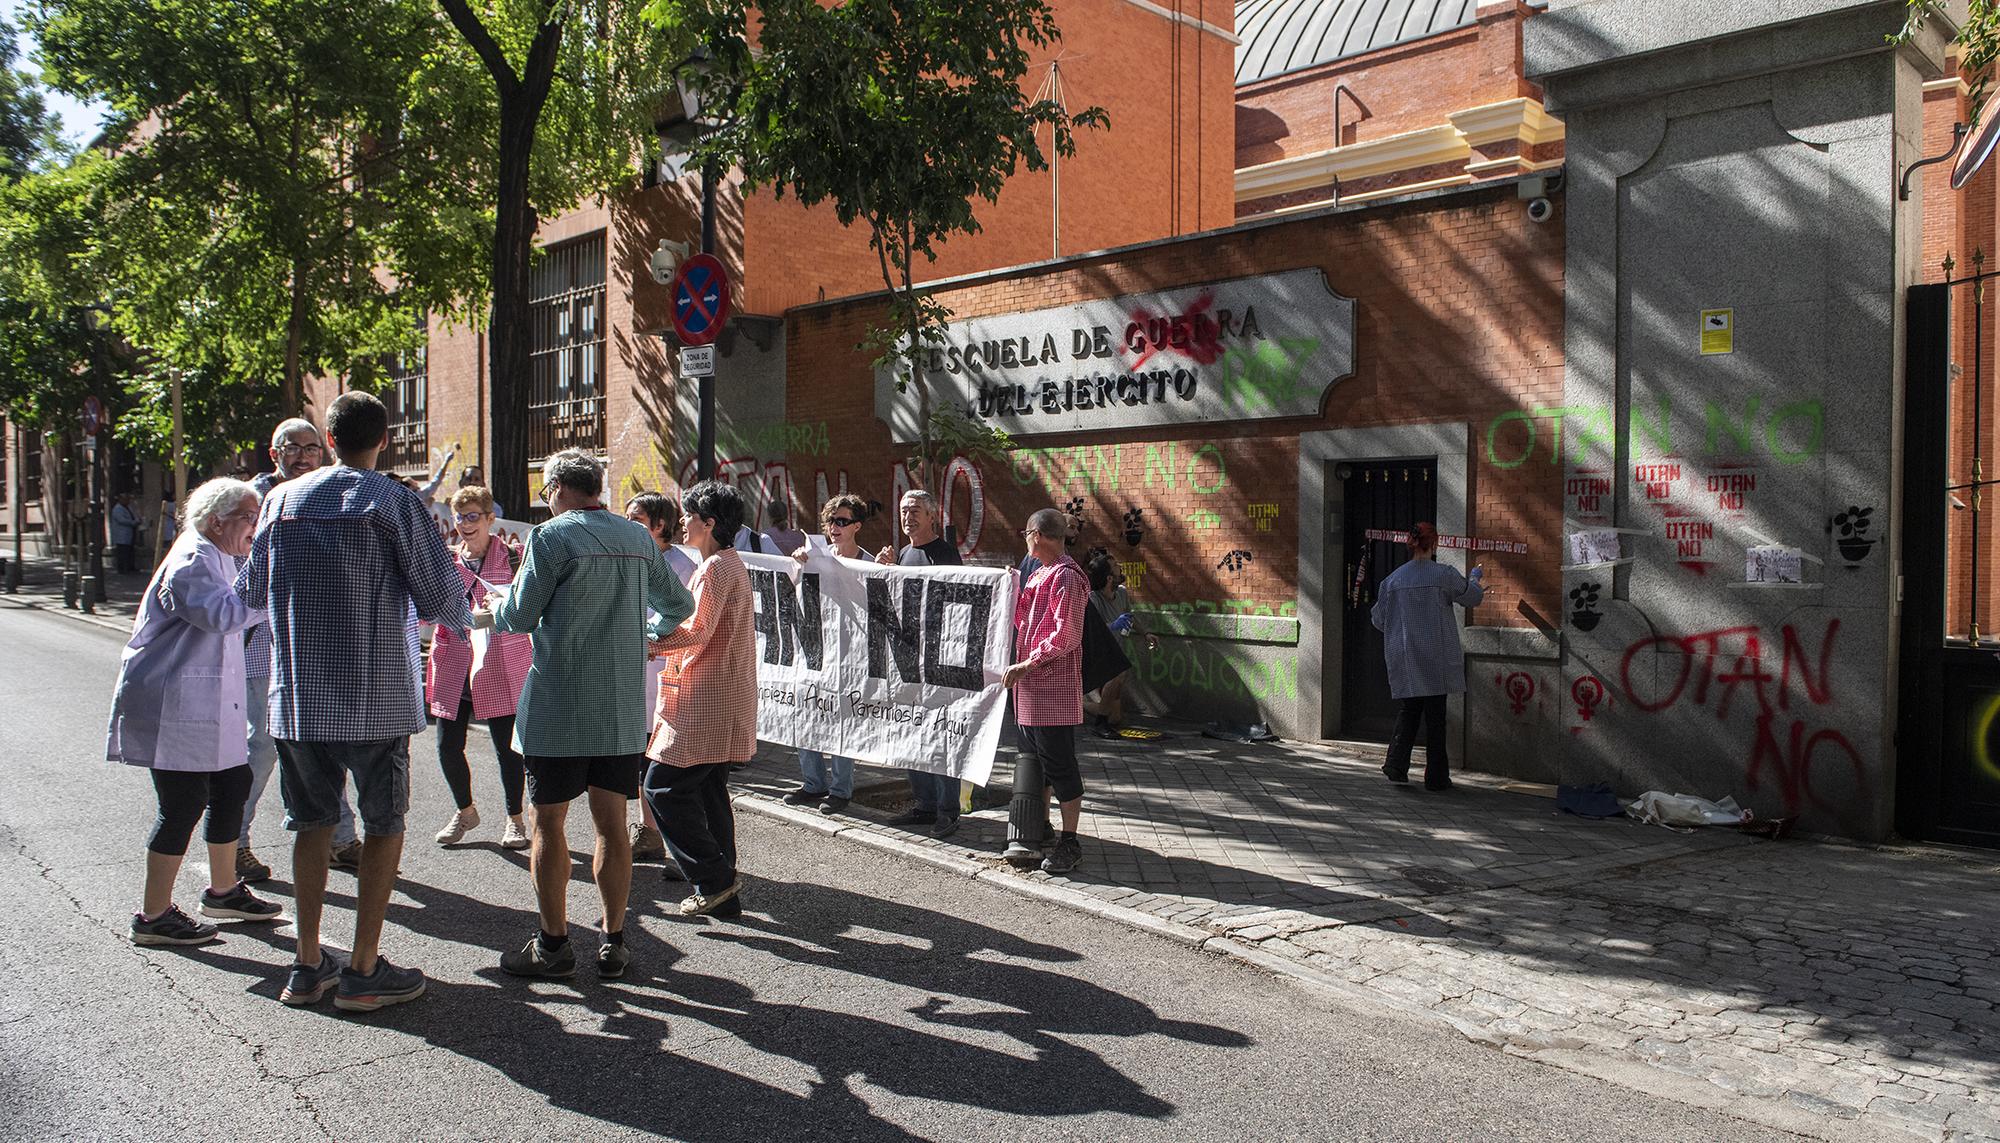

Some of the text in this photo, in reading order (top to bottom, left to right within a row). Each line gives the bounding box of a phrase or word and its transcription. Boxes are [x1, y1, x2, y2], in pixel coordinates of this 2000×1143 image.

[686, 352, 709, 361] ZONA DE
[928, 332, 1059, 376] ESCUELA
[1071, 325, 1112, 360] DE
[683, 361, 711, 371] SEGURIDAD
[977, 368, 1197, 418] DEL EJERCITO
[1486, 390, 1826, 469] OTAN NO
[1013, 440, 1226, 496] OTAN NO
[1635, 464, 1681, 482] OTAN
[1567, 478, 1610, 496] OTAN
[1646, 482, 1670, 499] NO
[1707, 474, 1756, 493] OTAN
[1248, 503, 1279, 518] OTAN
[1578, 495, 1600, 512] NO
[1719, 493, 1744, 510] NO
[1255, 518, 1271, 531] NO
[1666, 522, 1713, 540] OTAN
[1437, 535, 1455, 547] GAME
[1455, 537, 1471, 549] OVER
[1677, 540, 1702, 557] NO
[865, 577, 994, 693] NO
[1621, 618, 1842, 720] OTAN
[1746, 714, 1867, 812] NO
